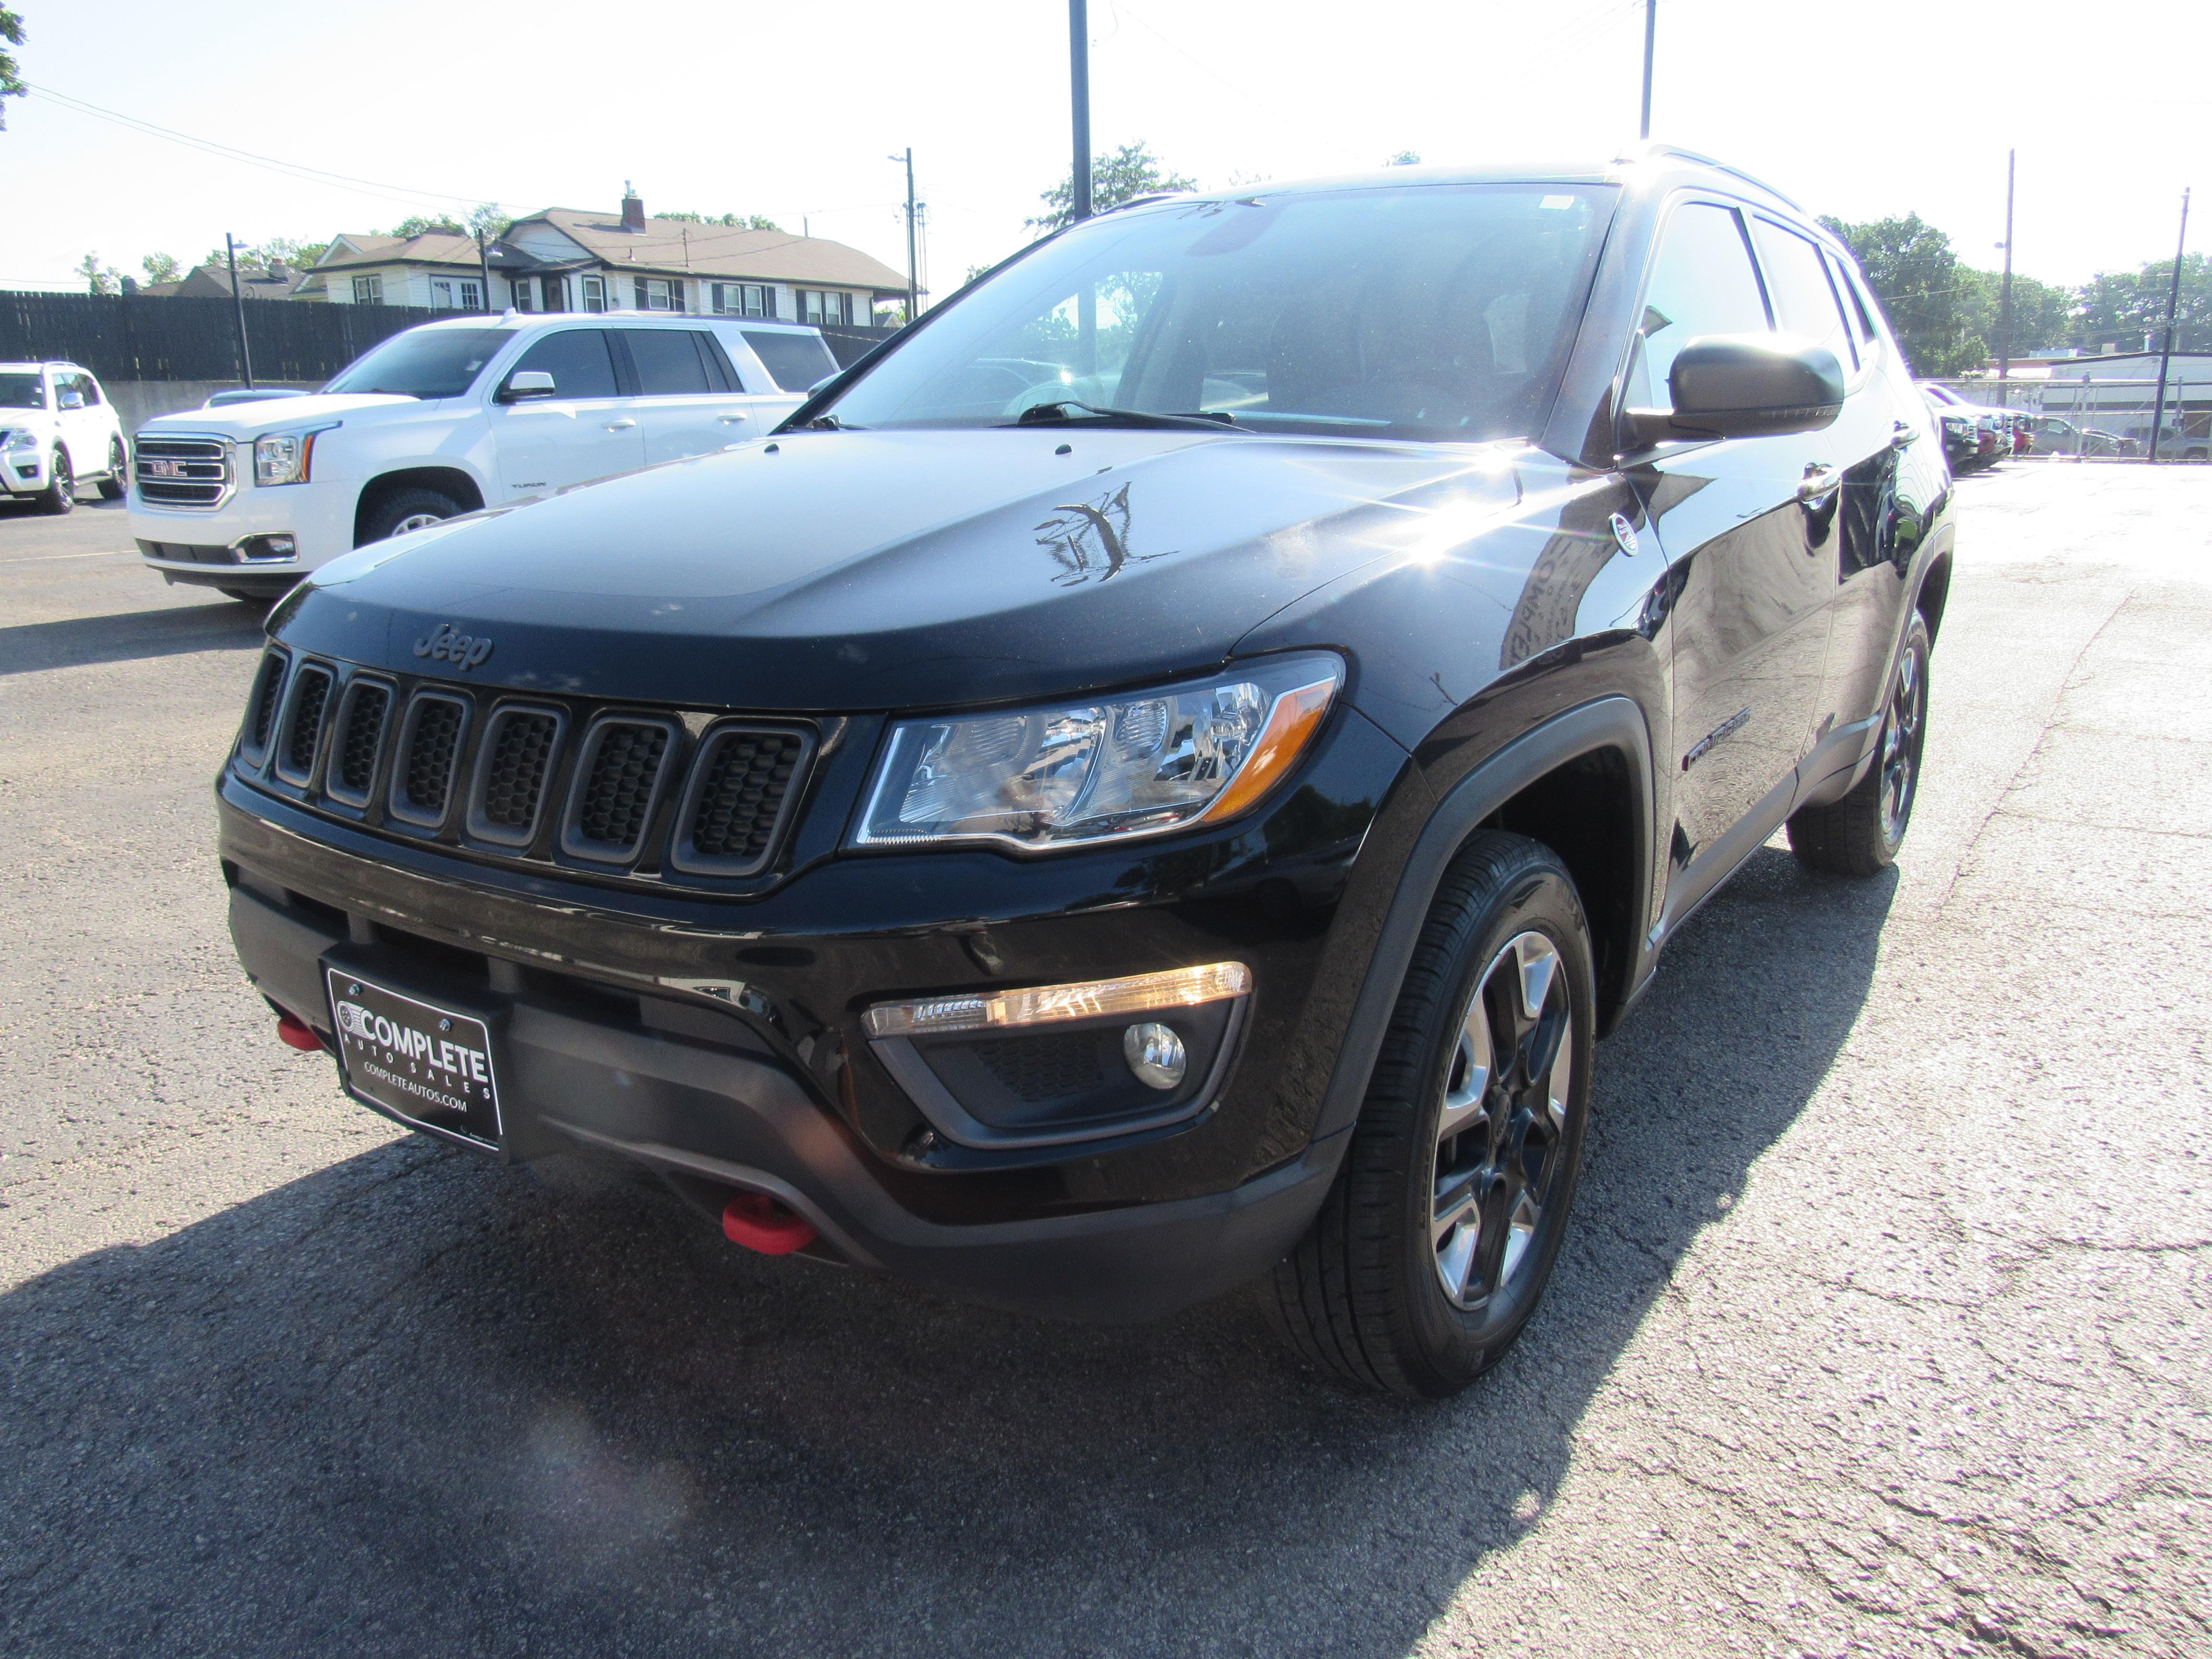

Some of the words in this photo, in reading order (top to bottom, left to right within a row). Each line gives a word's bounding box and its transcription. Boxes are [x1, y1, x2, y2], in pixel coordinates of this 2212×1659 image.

[152, 460, 187, 476] GMC
[413, 624, 493, 672] Jeep
[344, 1033, 394, 1064] AUTO
[410, 1062, 491, 1099] SALES
[360, 1010, 489, 1083] COMPLETE
[364, 1061, 467, 1112] COMPLETEAUTOS.COM
